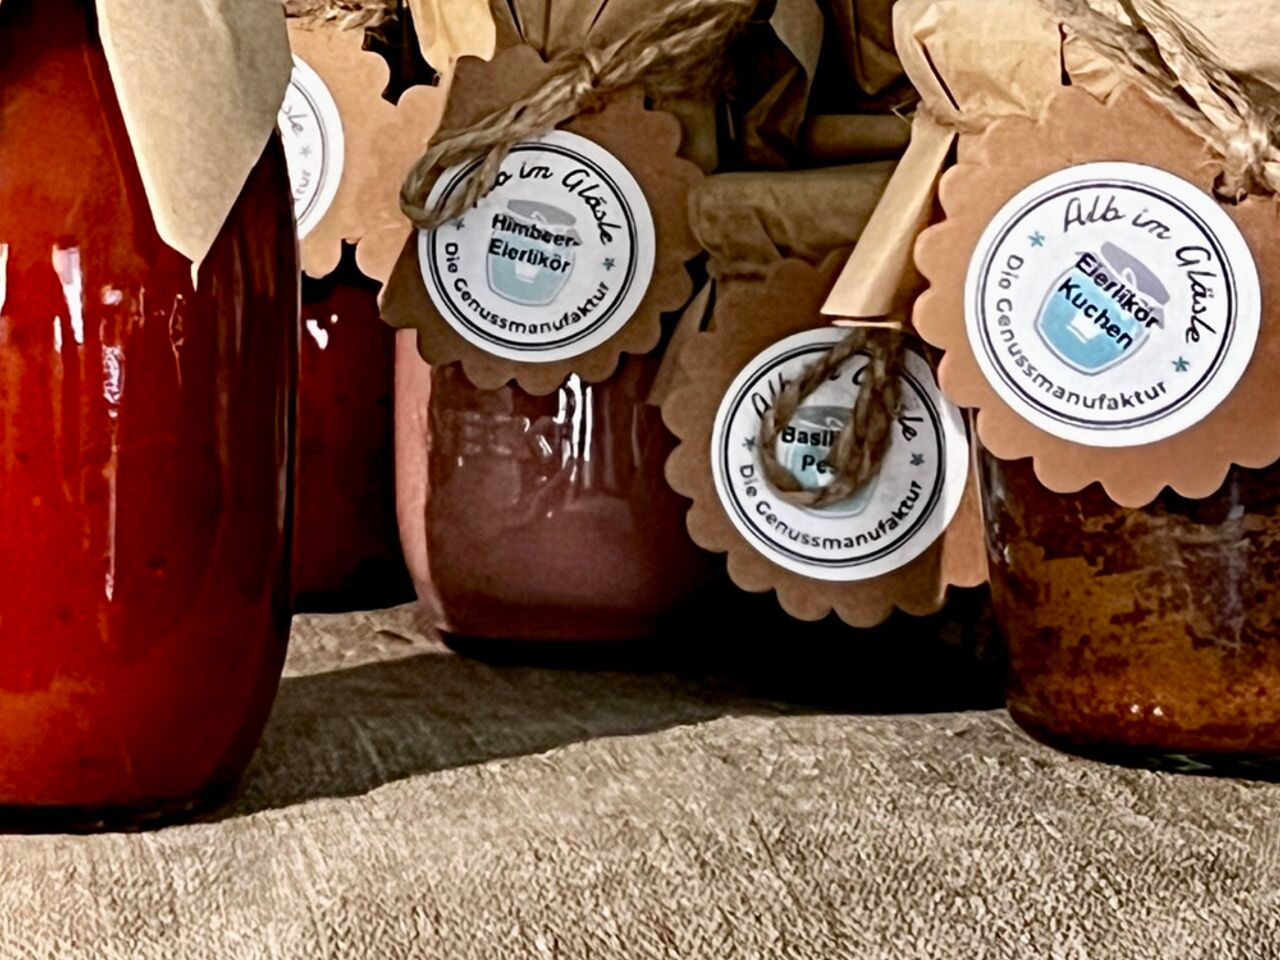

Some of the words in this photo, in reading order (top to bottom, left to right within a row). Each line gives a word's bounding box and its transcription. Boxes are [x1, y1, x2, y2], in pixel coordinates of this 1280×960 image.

[492, 213, 581, 247] Himbeer-
[562, 168, 622, 245] Gläsle
[445, 242, 460, 273] Die
[454, 278, 609, 334] Genussmanufaktur
[488, 237, 571, 274] Eierlikör
[997, 254, 1024, 291] Die
[1064, 195, 1125, 233] Alb
[1175, 245, 1217, 344] Gläsle
[1075, 251, 1160, 329] Eierlikör
[1057, 277, 1134, 351] Kuchen
[996, 297, 1168, 411] Genussmanufaktur
[781, 426, 835, 447] Basil
[740, 463, 757, 497] Die
[755, 480, 923, 550] Genussmanufaktur
